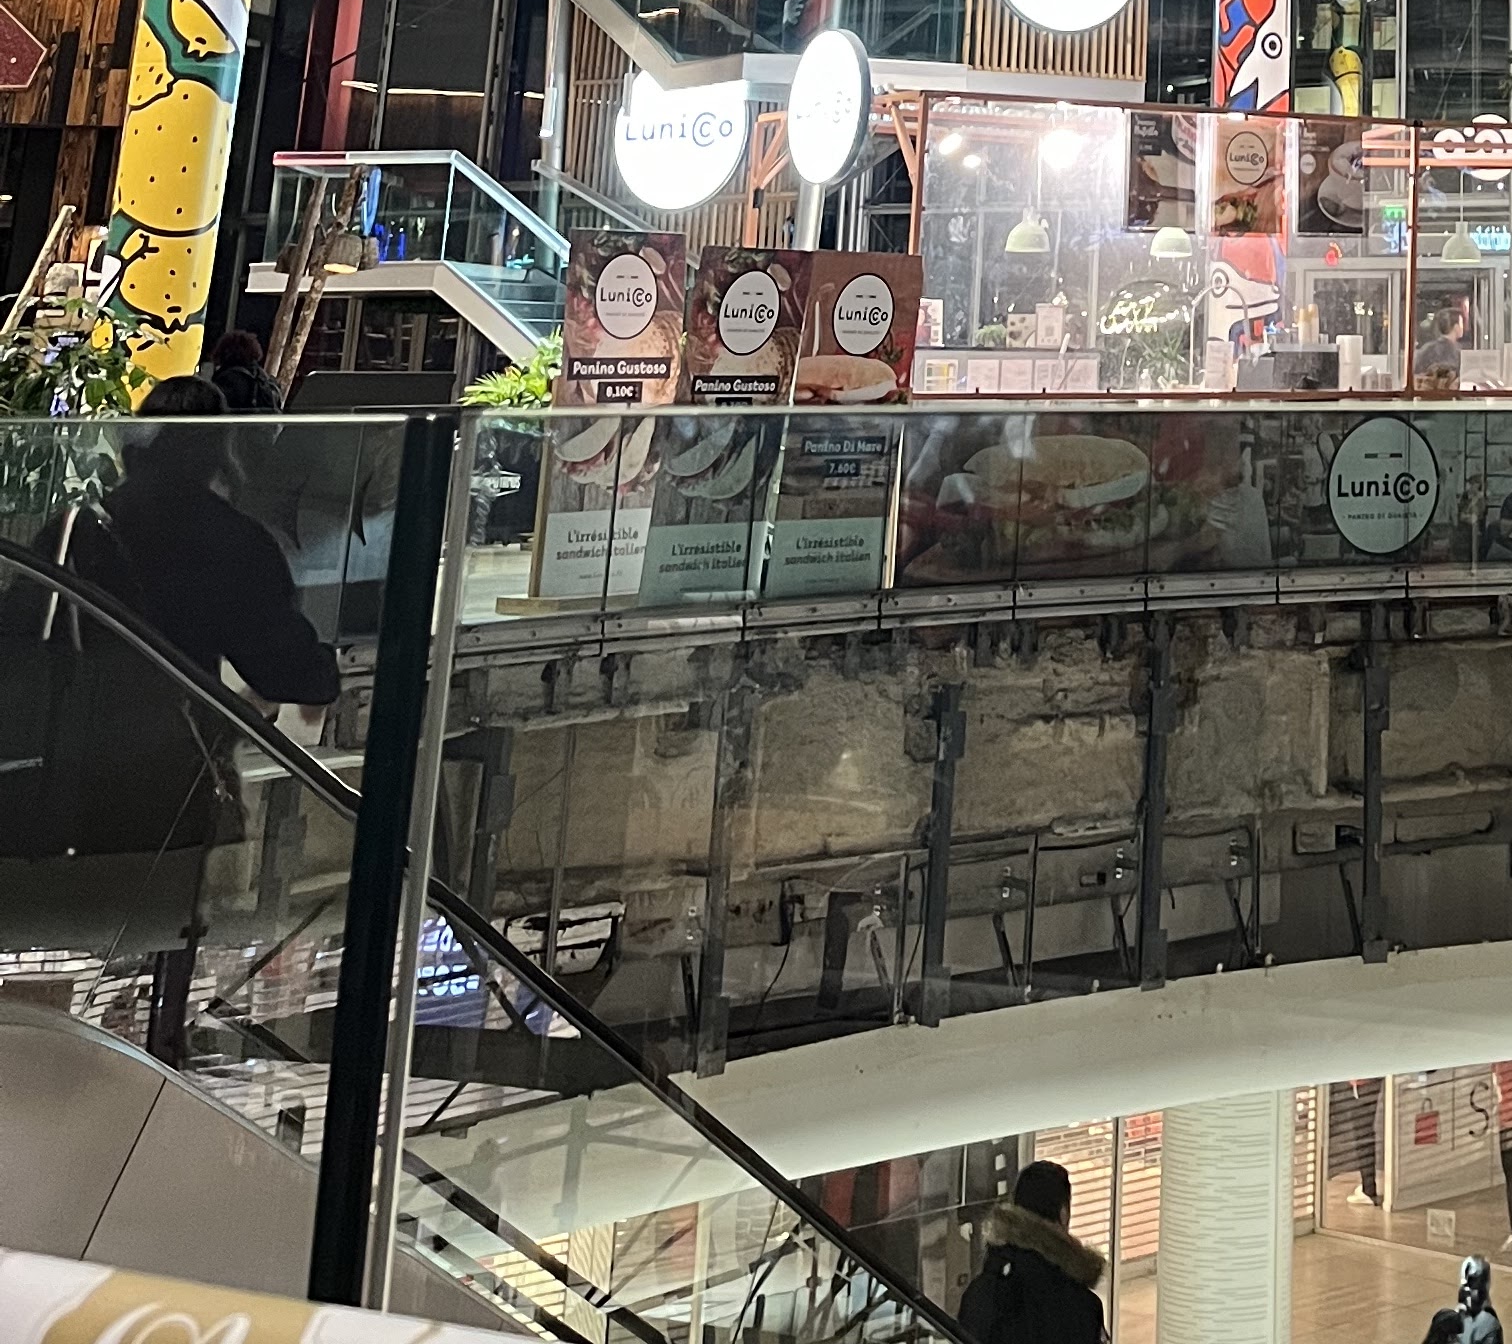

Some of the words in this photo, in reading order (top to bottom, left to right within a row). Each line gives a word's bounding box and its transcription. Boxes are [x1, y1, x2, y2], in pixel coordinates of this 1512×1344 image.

[572, 360, 616, 376] Panino
[617, 360, 668, 376] Gustoso
[694, 378, 732, 392] Panino
[733, 378, 776, 392] Gustoso
[804, 439, 841, 453] Panino
[842, 439, 855, 453] Di
